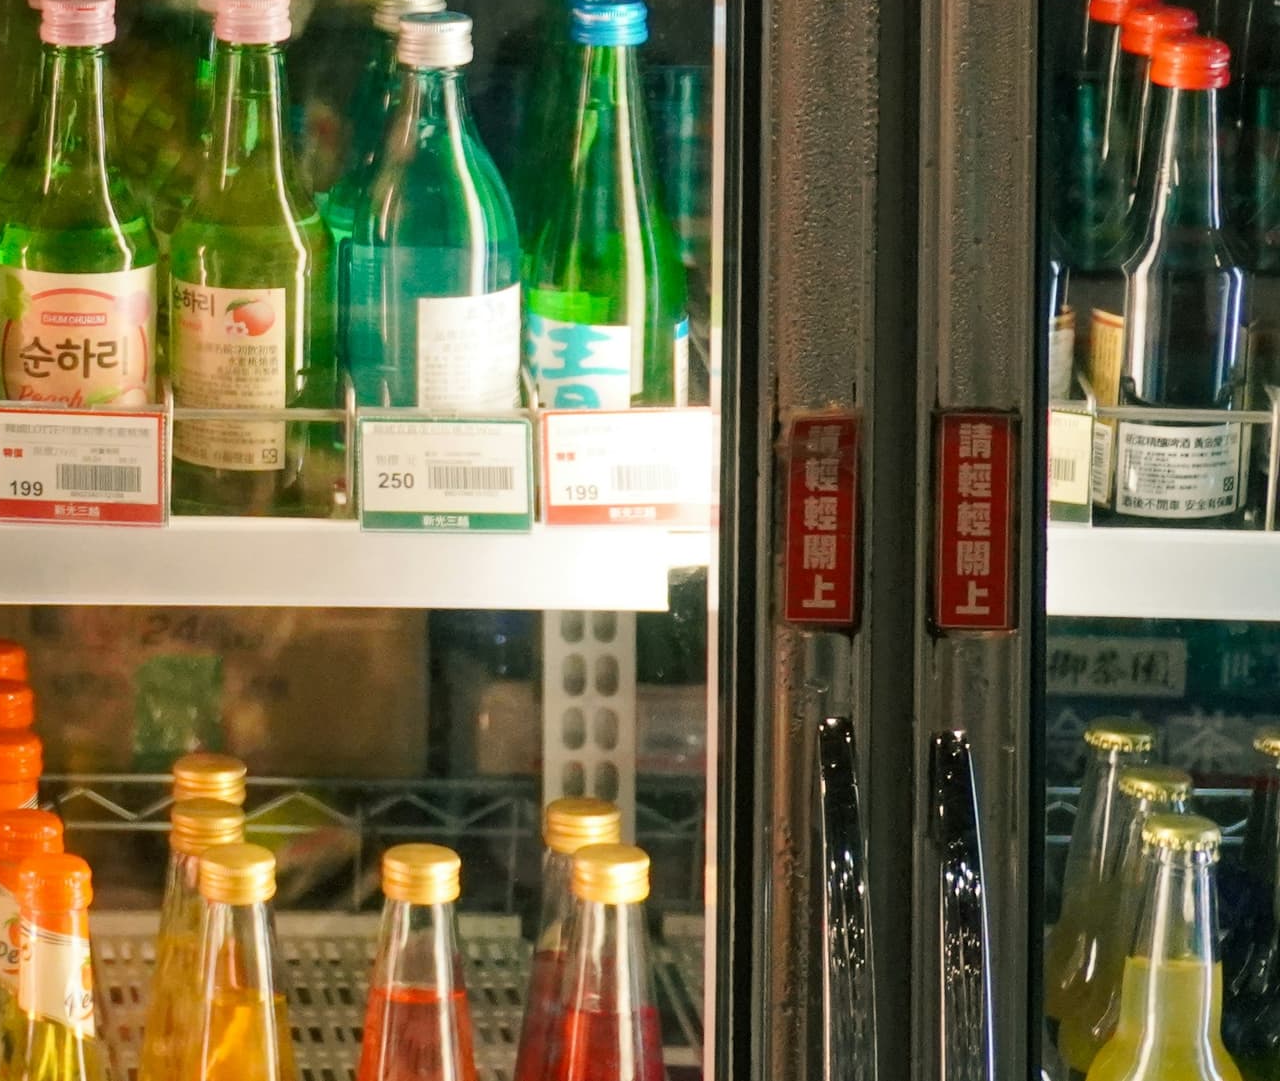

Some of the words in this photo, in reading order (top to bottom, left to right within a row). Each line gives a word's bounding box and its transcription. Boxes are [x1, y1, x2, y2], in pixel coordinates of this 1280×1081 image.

[19, 336, 129, 379] 순하리
[18, 384, 84, 409] Peach
[9, 479, 44, 498] 199
[377, 471, 416, 490] 250
[563, 484, 600, 502] 199
[53, 504, 101, 519] 新光三越
[608, 506, 657, 520] 新光三越
[422, 515, 470, 528] 新光三越
